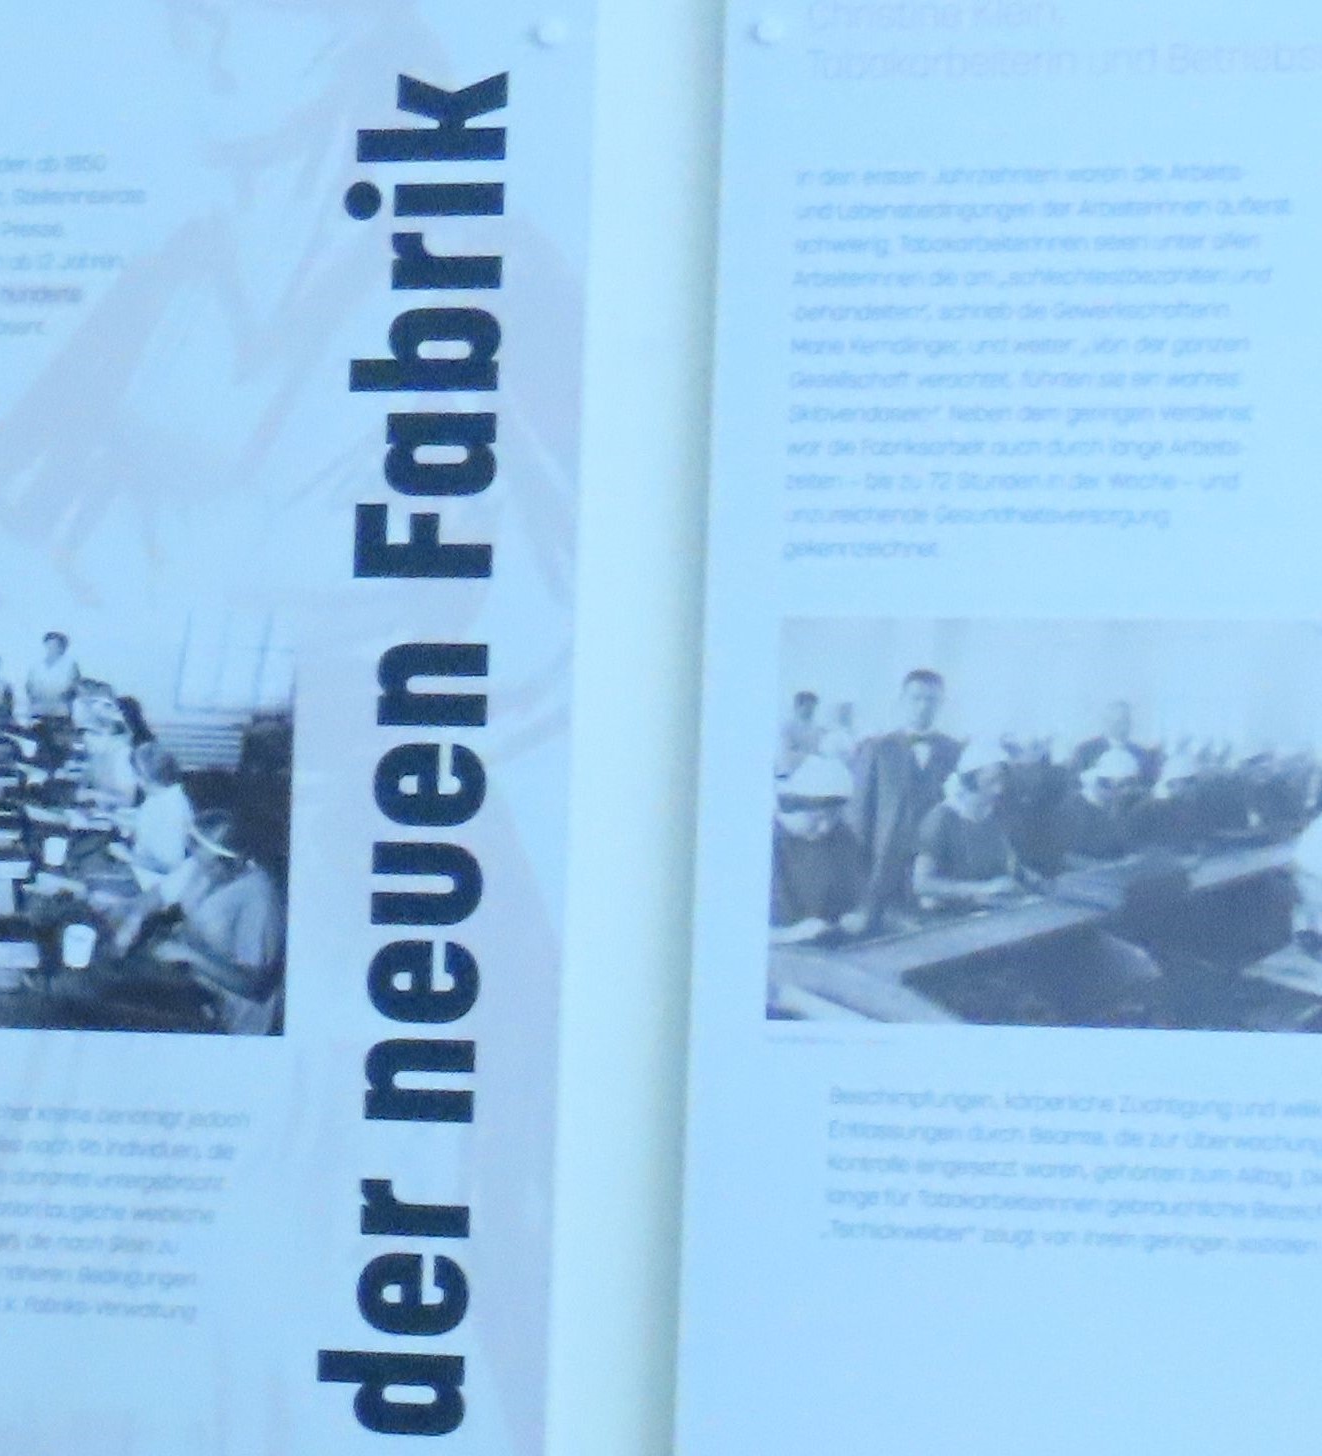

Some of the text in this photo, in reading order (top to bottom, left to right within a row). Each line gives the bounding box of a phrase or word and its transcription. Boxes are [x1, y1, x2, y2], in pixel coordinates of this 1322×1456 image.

[344, 70, 509, 579] Fabrik
[363, 642, 490, 1124] neuen
[317, 1177, 471, 1437] der
